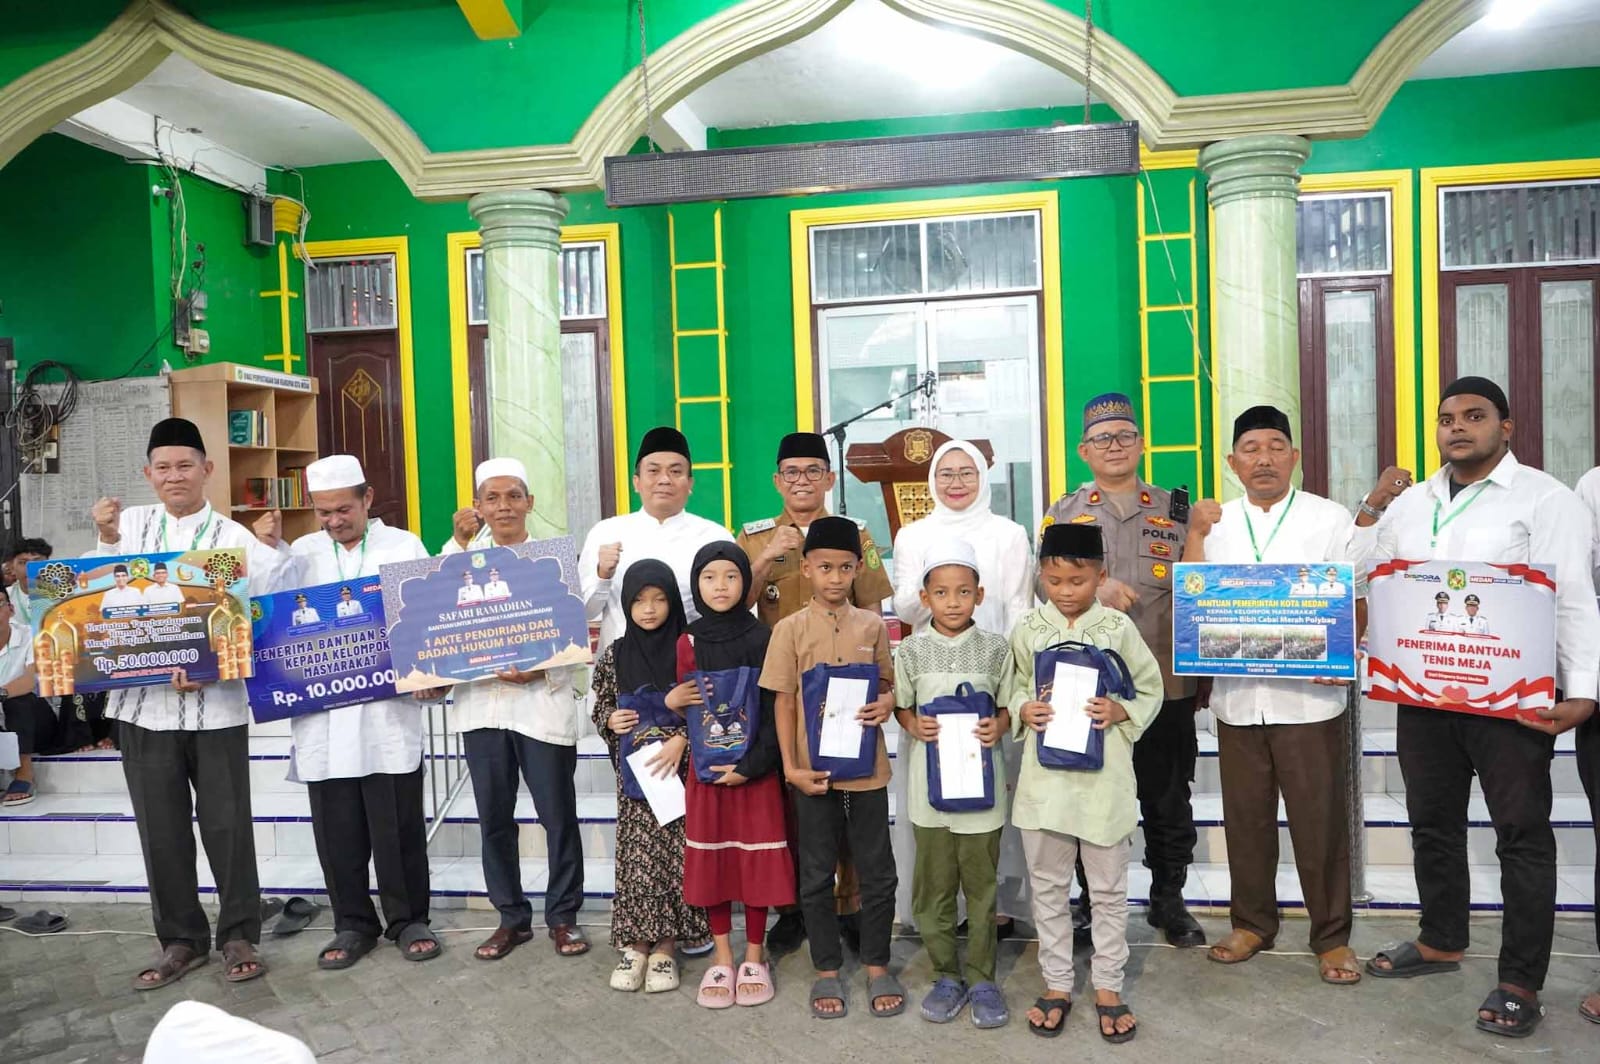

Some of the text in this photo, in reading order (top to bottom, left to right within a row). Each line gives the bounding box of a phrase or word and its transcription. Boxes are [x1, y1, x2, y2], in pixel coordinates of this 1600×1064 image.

[1142, 528, 1179, 542] POLRI
[363, 585, 382, 593] MEDA
[438, 609, 474, 623] SAFARI
[475, 599, 533, 616] RAMADHAN
[1197, 599, 1231, 607] BANTUAN
[1301, 600, 1328, 608] MEDAN
[84, 616, 202, 633] Kegiatan Pemberdayaan
[1239, 615, 1258, 623] Bibit
[1305, 616, 1337, 625] Polybag
[417, 628, 561, 661] BADAN HUKUM KOPERASI
[424, 618, 554, 648] 1 AKTE PENDIRIAN DAN
[253, 641, 314, 664] PENERIMA
[318, 630, 375, 650] BANTUAN
[284, 640, 391, 671] KEPADA KELOMPOK
[1396, 638, 1521, 660] PENERIMA BANTUAN
[93, 656, 117, 675] Rp.
[118, 648, 199, 669] 50.000.000
[303, 654, 378, 679] MASYARAKAT
[1422, 654, 1492, 671] TENIS MEJA
[271, 690, 304, 707] Rp.
[305, 669, 396, 700] 10.000.00
